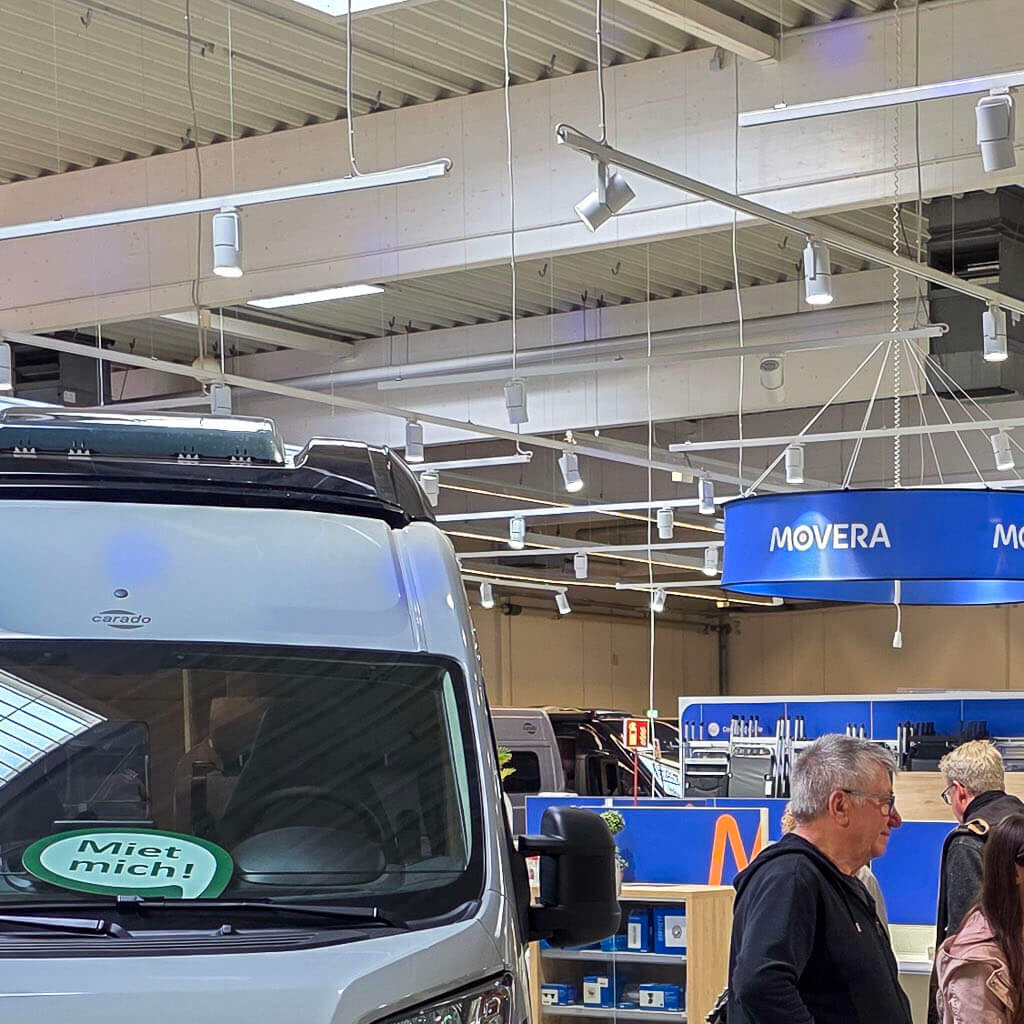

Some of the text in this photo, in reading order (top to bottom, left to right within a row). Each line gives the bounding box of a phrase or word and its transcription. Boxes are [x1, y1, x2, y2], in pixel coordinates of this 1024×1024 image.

[770, 522, 892, 552] MOVERA
[91, 615, 152, 624] carado
[78, 839, 181, 859] Miet
[69, 859, 194, 879] mich!
